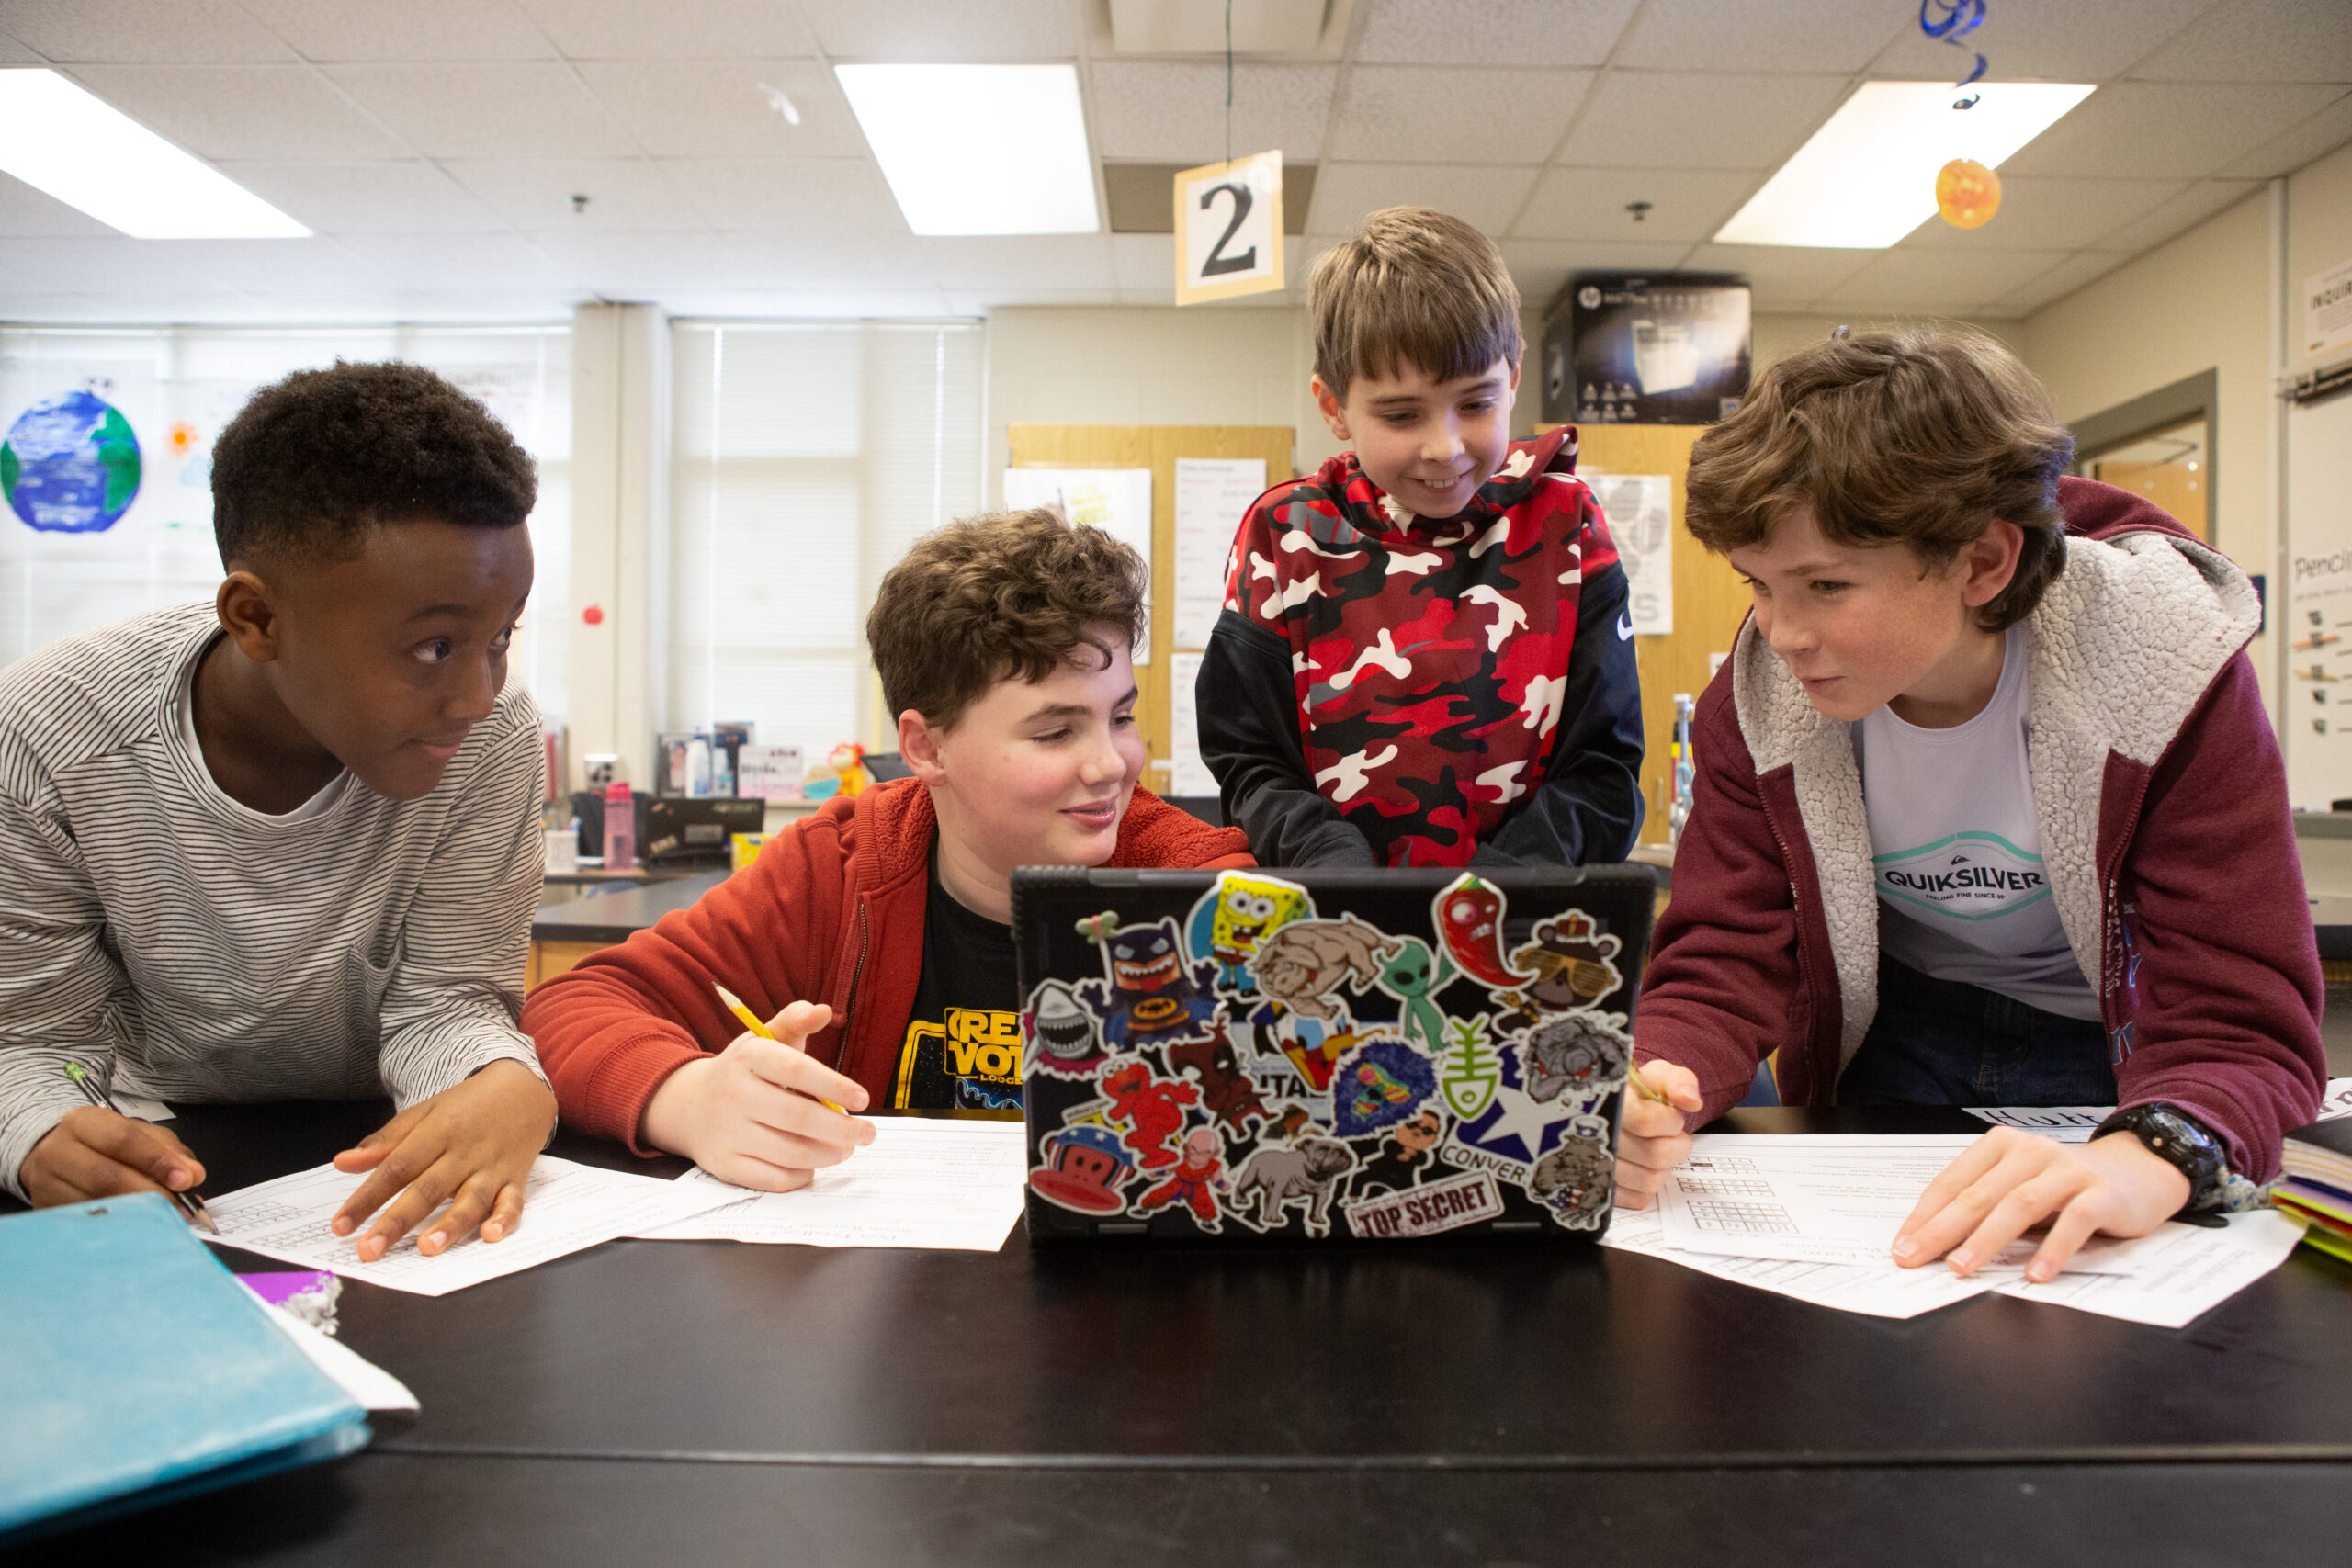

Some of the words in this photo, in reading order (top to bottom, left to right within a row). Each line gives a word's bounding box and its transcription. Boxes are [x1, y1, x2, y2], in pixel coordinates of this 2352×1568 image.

[1201, 182, 1256, 277] 2
[1885, 867, 2045, 892] QUIKSILVER
[1442, 1145, 1529, 1184] CONVER
[1358, 1206, 1402, 1237] TOP
[1406, 1181, 1488, 1226] SECRET
